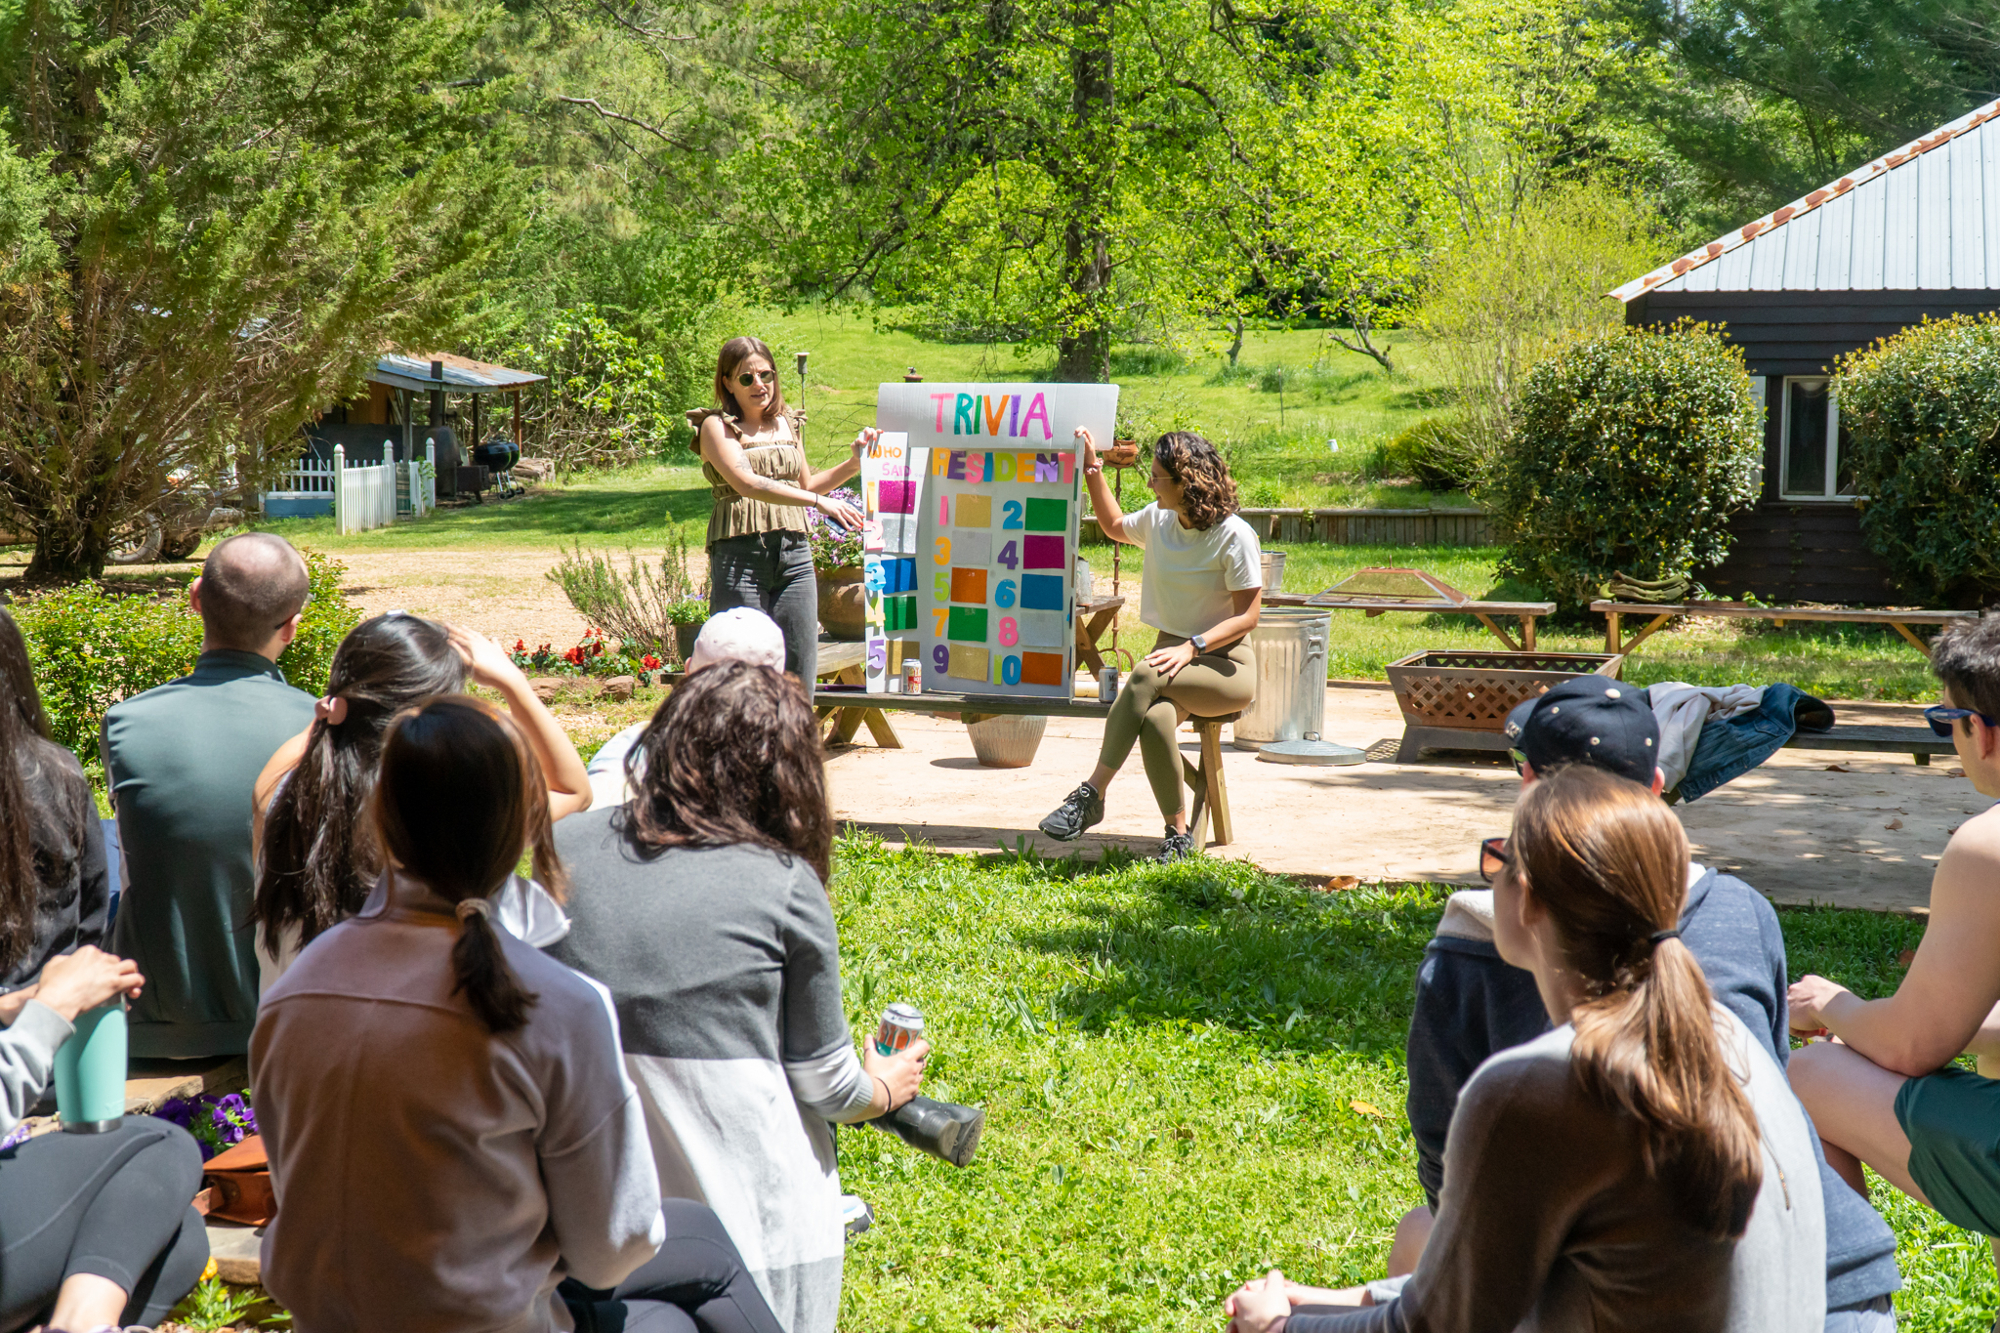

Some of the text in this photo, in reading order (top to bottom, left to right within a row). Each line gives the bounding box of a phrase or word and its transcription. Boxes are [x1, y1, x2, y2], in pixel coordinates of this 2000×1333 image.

[930, 392, 1053, 440] TRIVIA
[867, 445, 902, 459] WHO
[932, 447, 1076, 484] RESIDENT
[1002, 500, 1023, 529] 2
[864, 520, 886, 549] 2
[933, 536, 952, 566] 3
[997, 540, 1019, 570] 4
[865, 562, 887, 591] 3
[934, 572, 950, 601] 5
[995, 579, 1016, 608] 6
[865, 597, 886, 627] 4
[932, 608, 950, 637] 7
[998, 616, 1019, 647] 8
[868, 639, 887, 669] 5
[933, 644, 949, 674] 9
[993, 654, 1021, 685] 10
